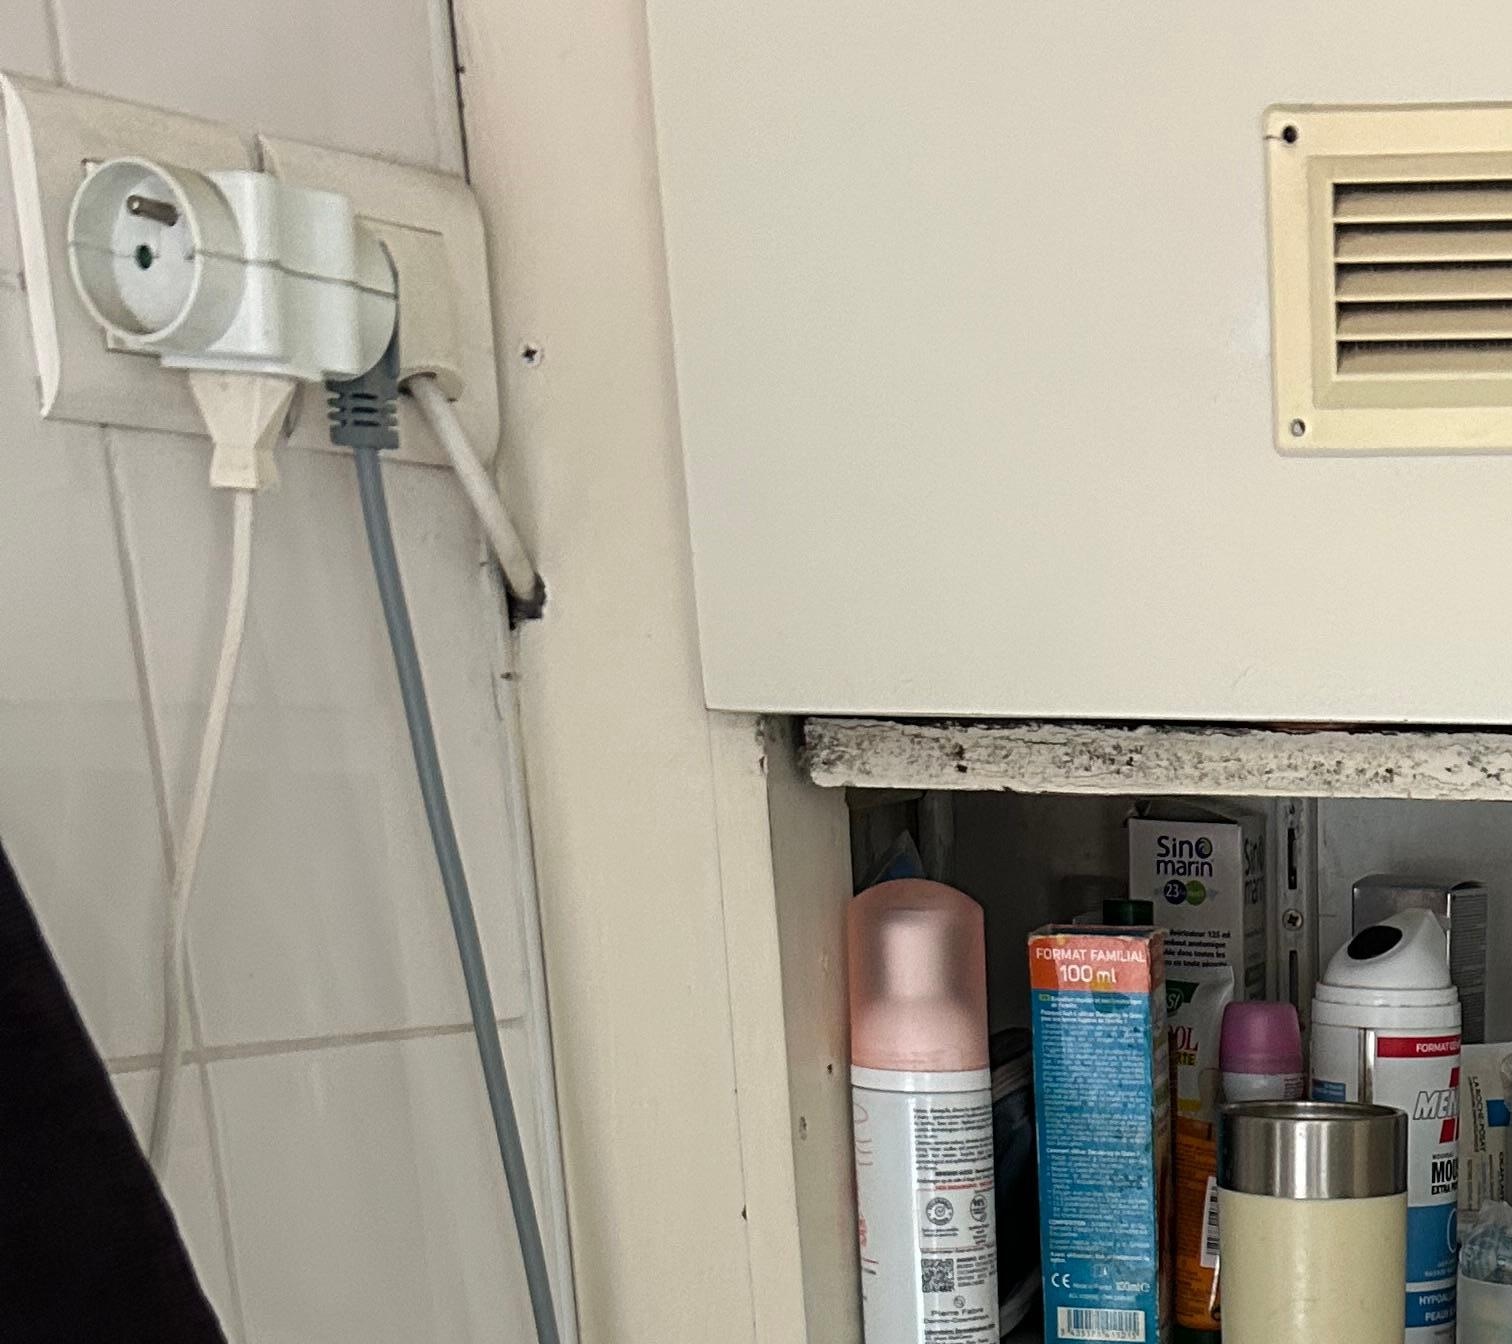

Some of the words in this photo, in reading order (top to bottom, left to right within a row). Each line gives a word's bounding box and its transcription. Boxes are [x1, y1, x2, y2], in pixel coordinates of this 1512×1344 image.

[1156, 859, 1213, 877] marin
[1036, 947, 1087, 960] FORMAT
[1090, 949, 1147, 963] FAMILIAL
[1059, 964, 1094, 983] 100
[1096, 967, 1117, 984] ml
[1416, 1043, 1450, 1053] FORMAT
